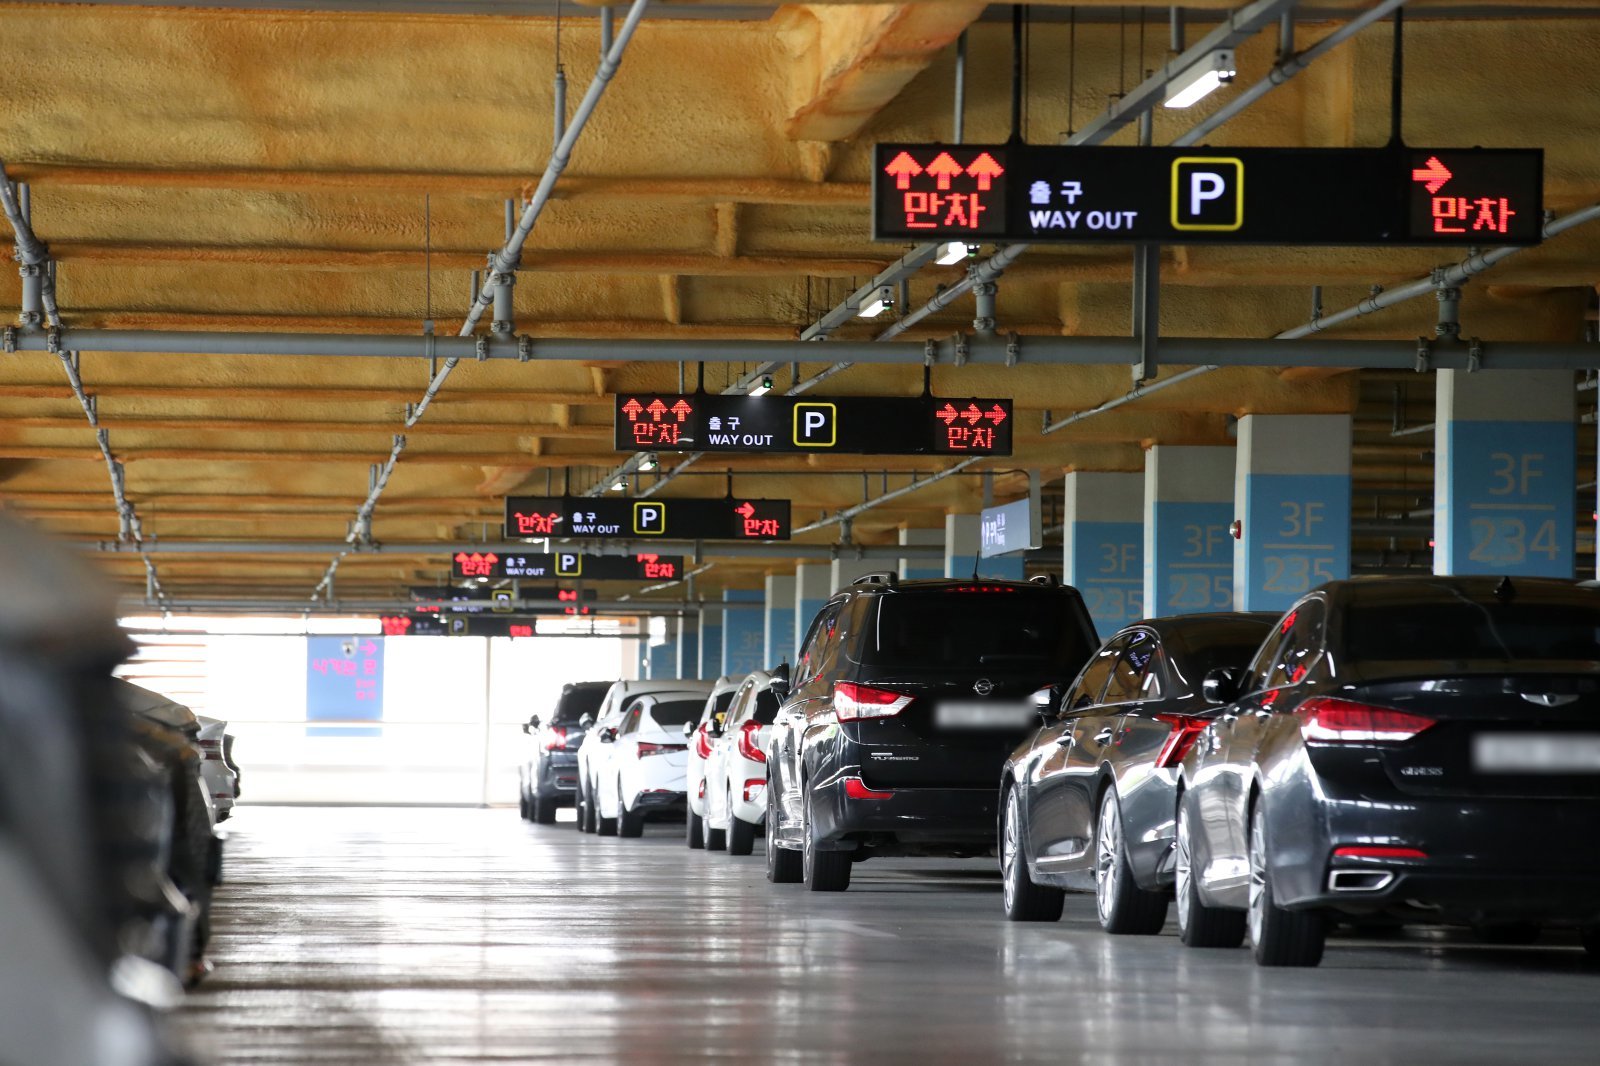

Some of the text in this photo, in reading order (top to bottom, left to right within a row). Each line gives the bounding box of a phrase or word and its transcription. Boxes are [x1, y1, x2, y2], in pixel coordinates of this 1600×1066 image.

[1190, 172, 1225, 216] P
[903, 191, 986, 229] 만차
[1029, 211, 1138, 230] WAY OUT
[1431, 197, 1516, 234] 만차
[633, 423, 682, 445] 만차
[805, 412, 825, 437] P
[947, 426, 996, 449] 만차
[708, 434, 773, 446] WAY OUT
[1488, 452, 1544, 496] 3F
[573, 524, 620, 534] WAY OUT
[641, 508, 657, 528] P
[744, 519, 780, 537] 만차
[1280, 501, 1325, 537] 3F
[1183, 524, 1224, 557] 3F
[1468, 518, 1560, 562] 234
[506, 567, 545, 576] WAY OUT
[562, 554, 575, 572] P
[645, 563, 675, 578] 만차
[1099, 543, 1136, 573] 3F
[1263, 556, 1335, 593] 235
[1168, 573, 1233, 608] 235
[1084, 587, 1144, 622] 235
